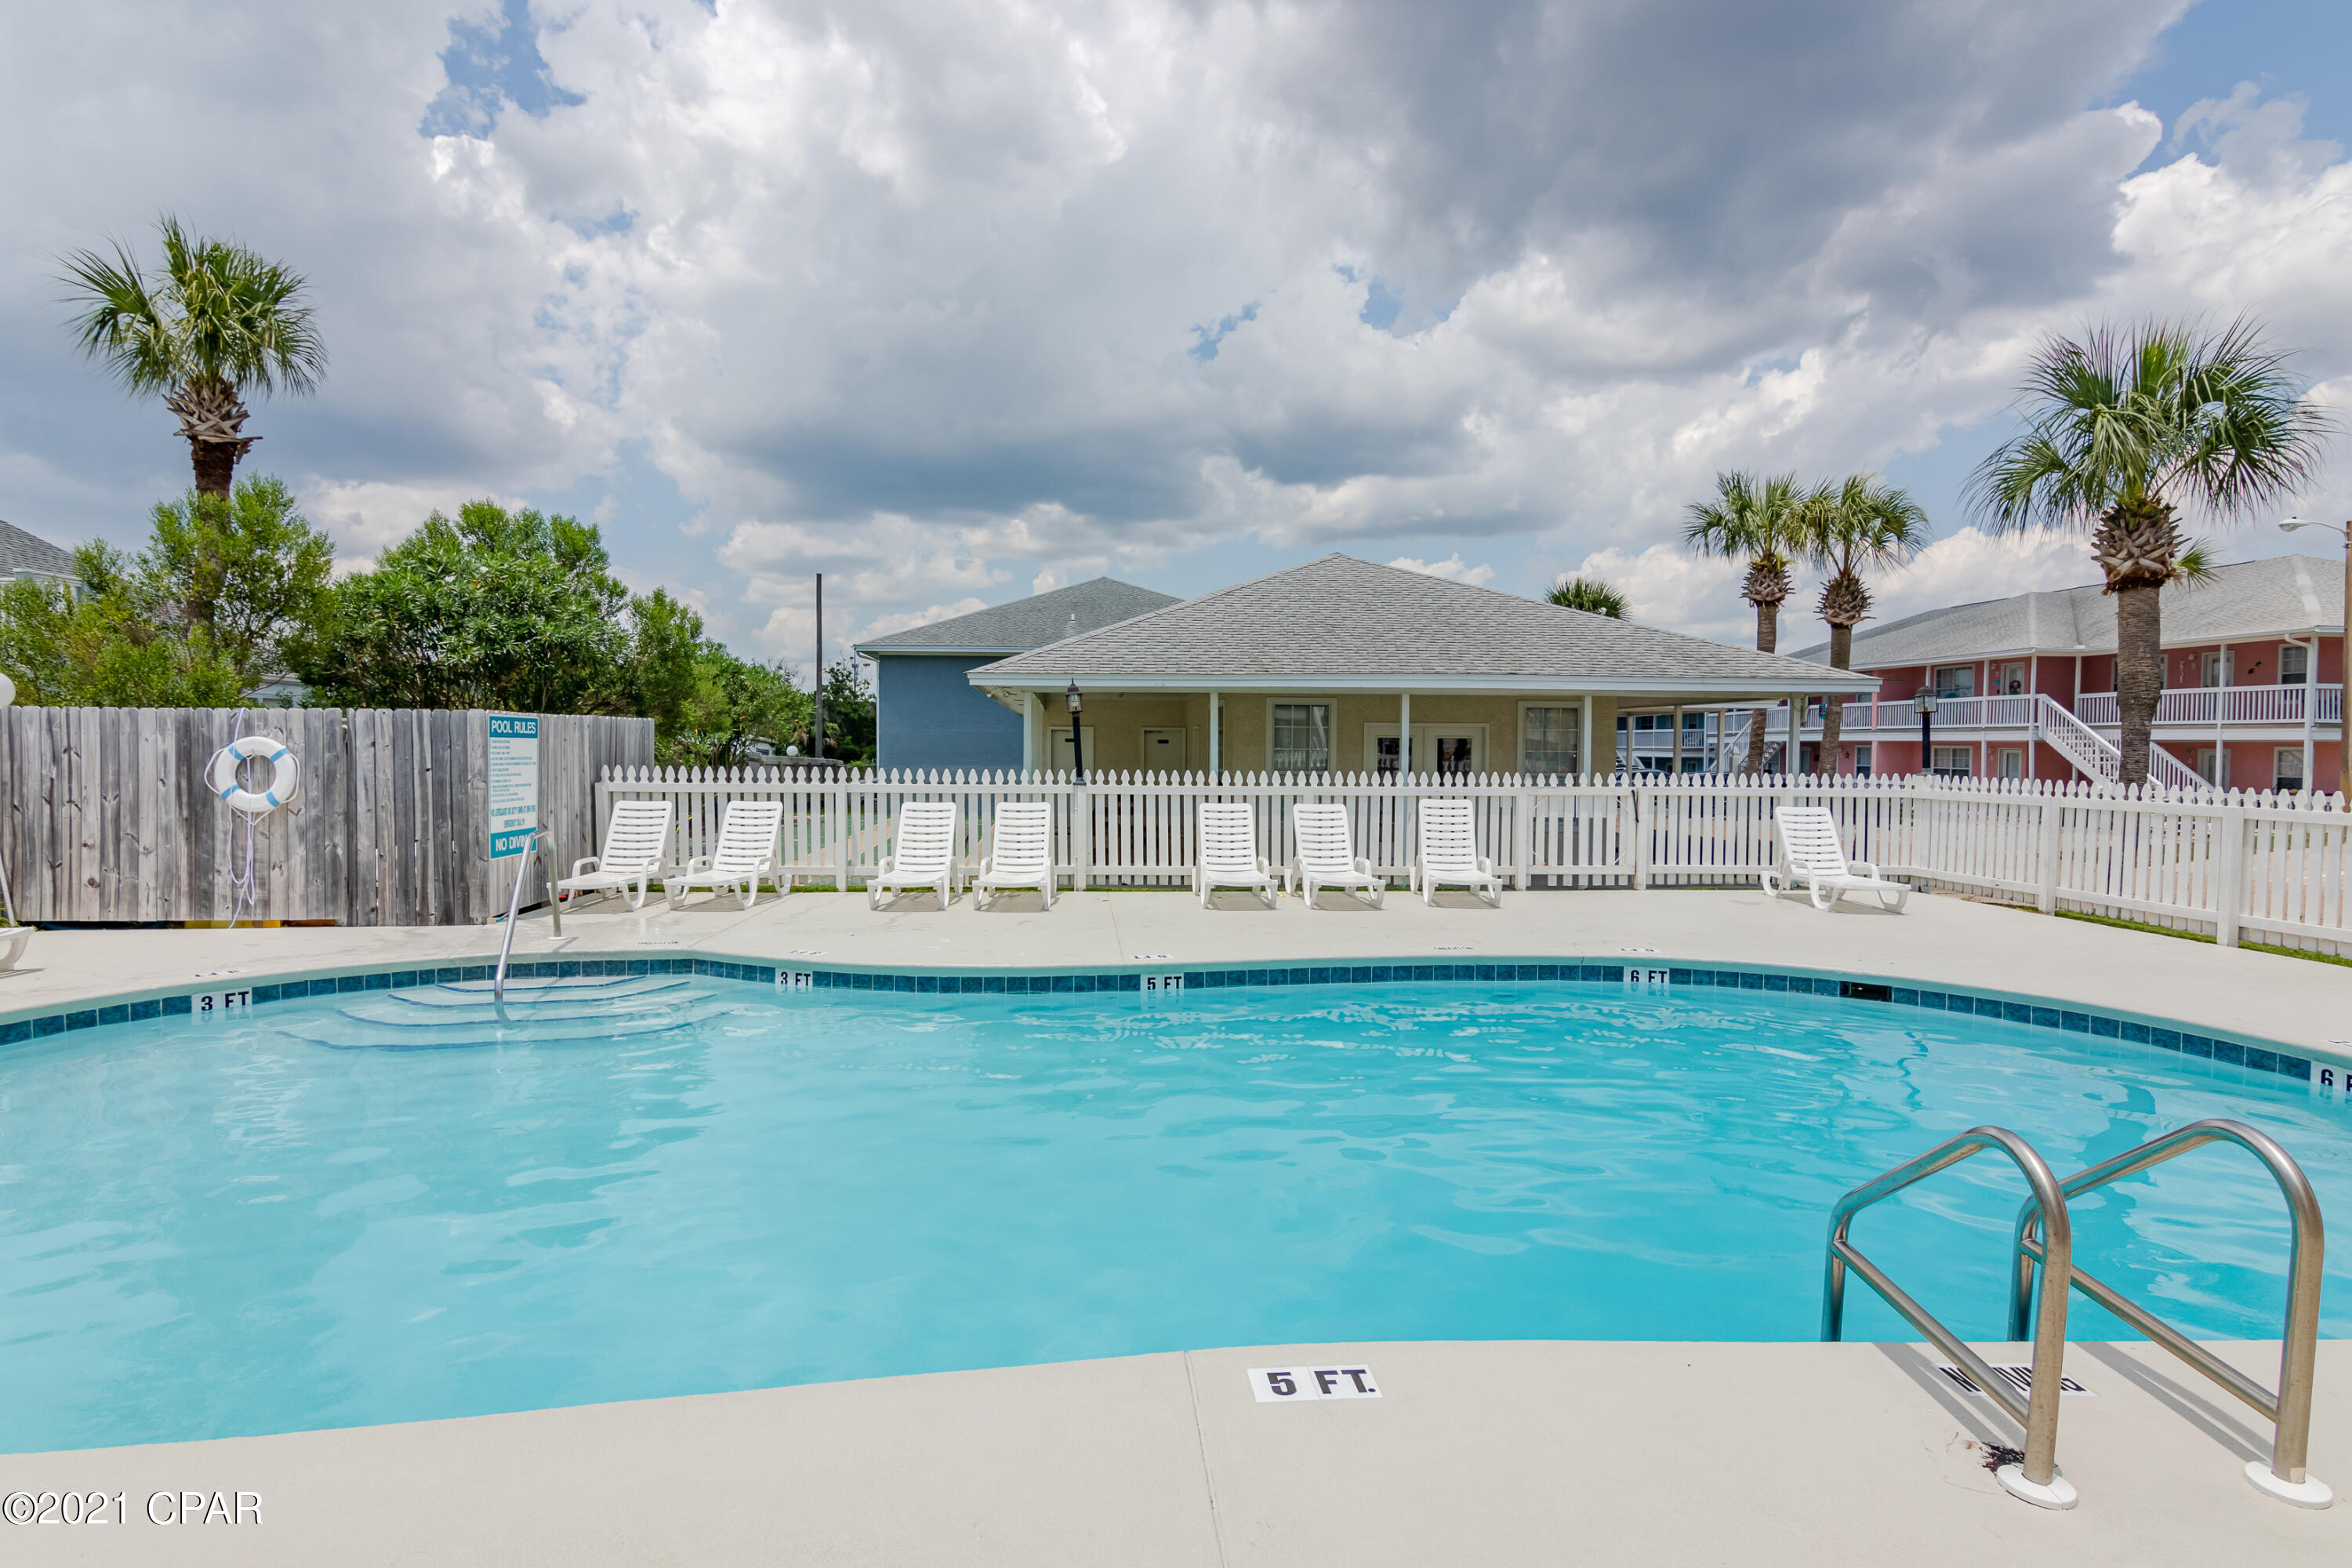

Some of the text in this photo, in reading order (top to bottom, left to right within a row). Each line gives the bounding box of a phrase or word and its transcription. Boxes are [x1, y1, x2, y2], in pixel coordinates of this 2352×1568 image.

[491, 720, 536, 735] POOL RULES
[495, 834, 528, 851] NO DIVIN
[780, 971, 811, 986] 3 FT
[1147, 976, 1182, 990] 5 FT
[1631, 970, 1668, 983] 6 FT
[201, 991, 249, 1011] 3 FT
[2321, 1069, 2333, 1087] 6
[1267, 1369, 1376, 1396] 5 FT.
